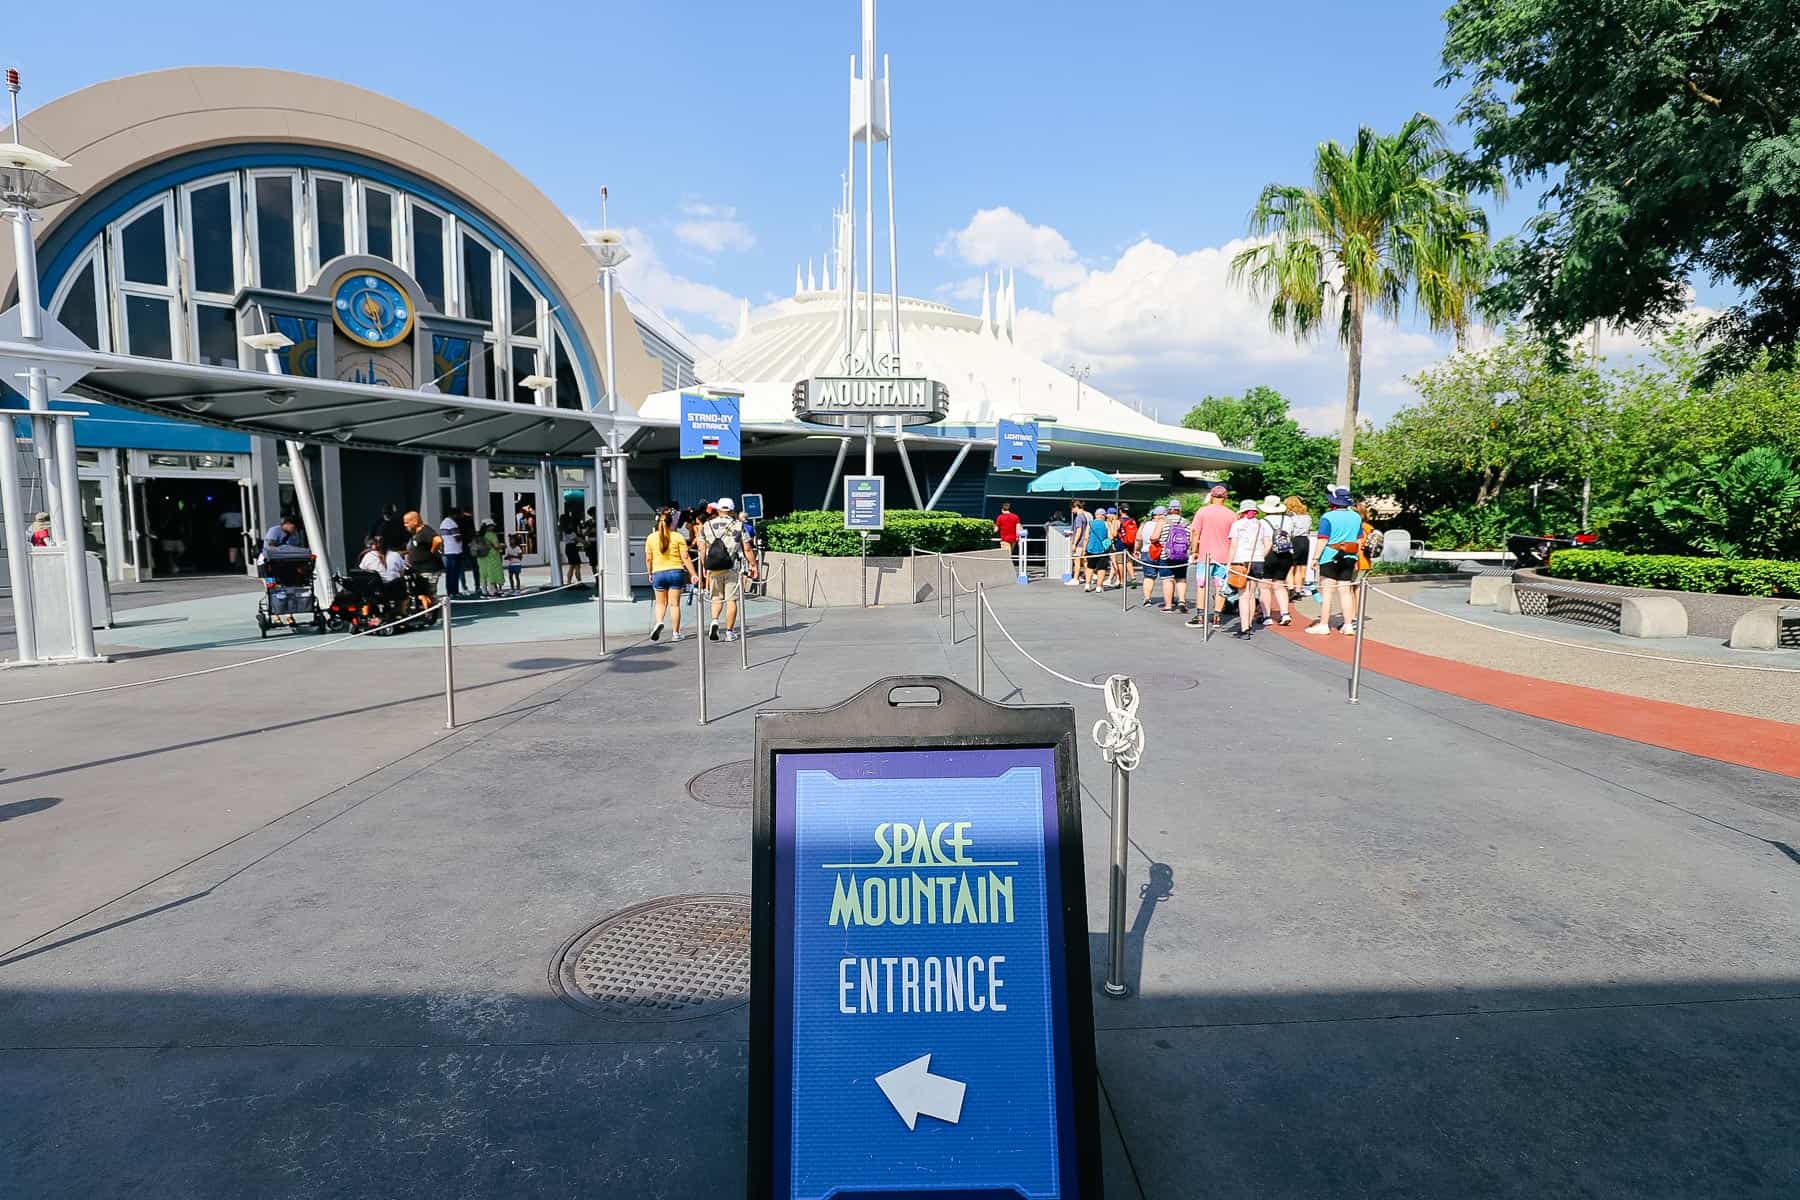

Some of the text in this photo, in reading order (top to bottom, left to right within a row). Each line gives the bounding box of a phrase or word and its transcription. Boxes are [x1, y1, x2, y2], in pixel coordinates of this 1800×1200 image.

[842, 352, 900, 376] SPACE
[816, 379, 926, 407] MOUNTAIN
[688, 413, 733, 423] STAND-BY
[874, 816, 974, 864] SPACE
[829, 870, 1015, 931] MOUNTAIN
[840, 956, 1008, 1014] ENTRANCE
